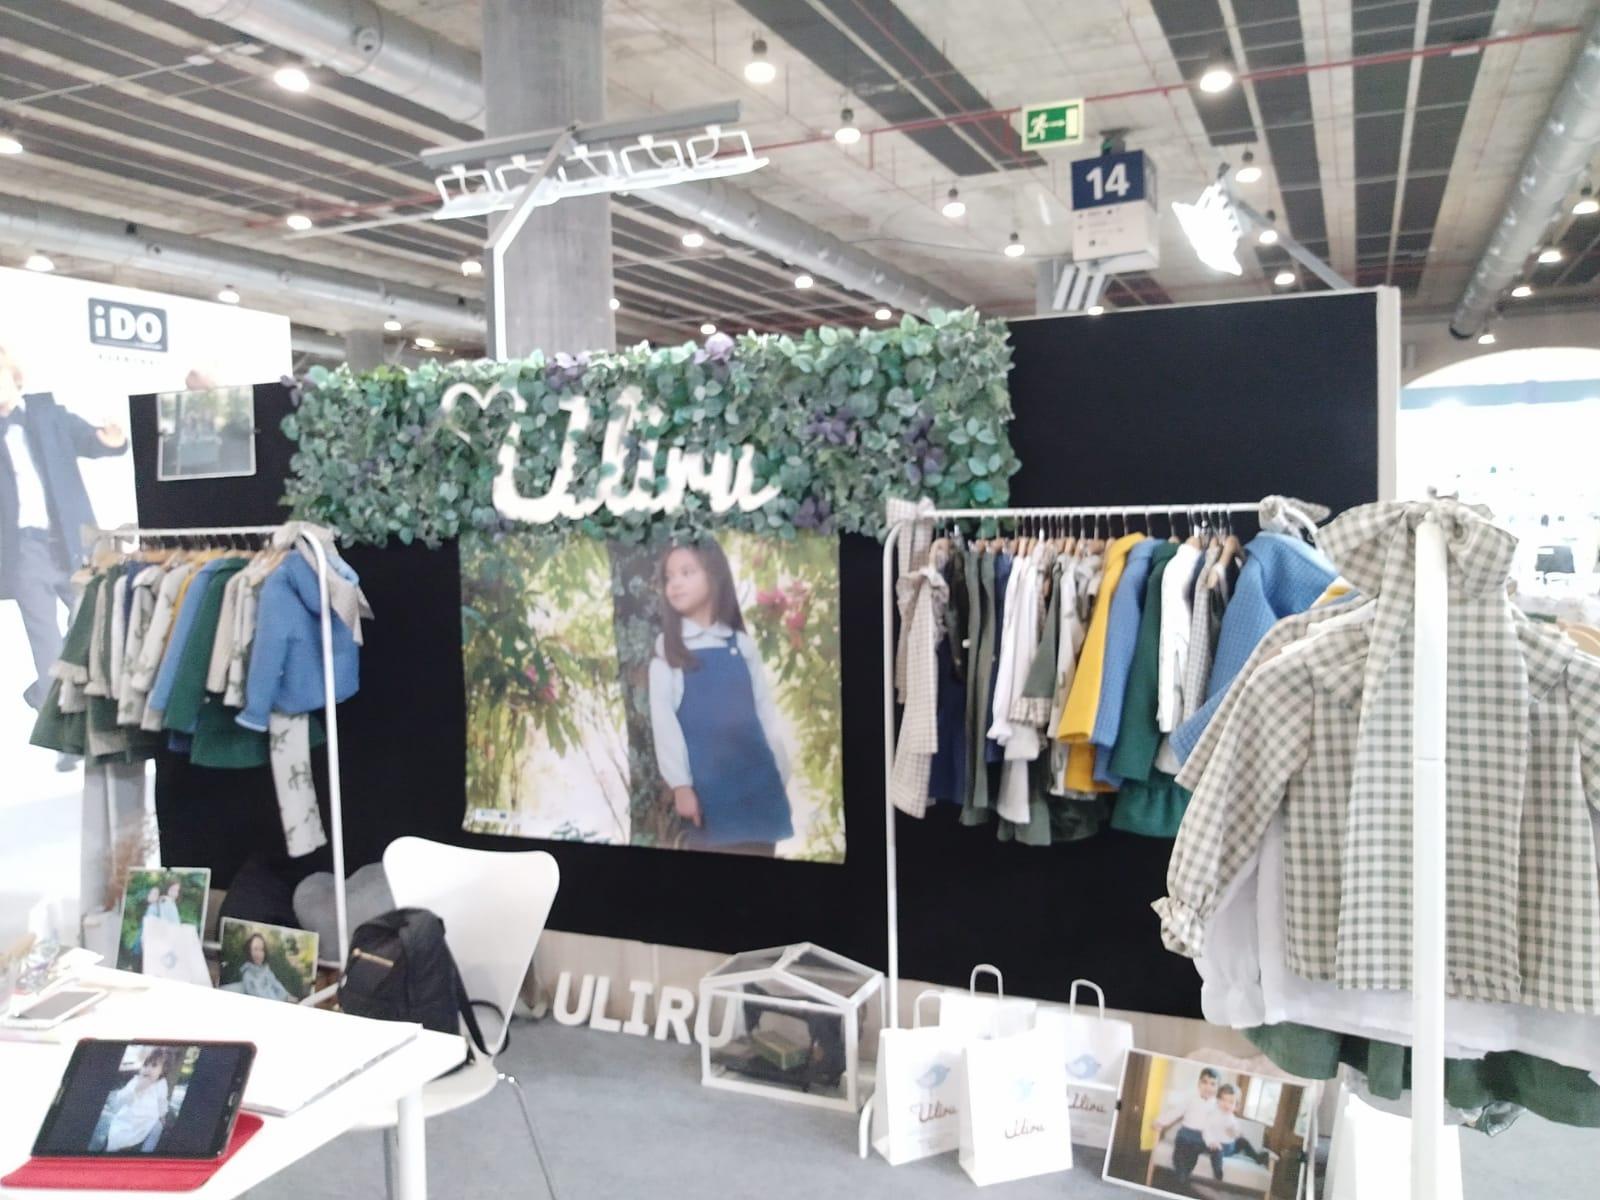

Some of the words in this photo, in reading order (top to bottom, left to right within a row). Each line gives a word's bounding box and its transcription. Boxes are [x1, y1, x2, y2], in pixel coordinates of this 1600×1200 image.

[1085, 161, 1131, 201] 14
[93, 303, 164, 344] iDO
[552, 970, 739, 1048] ULIRU
